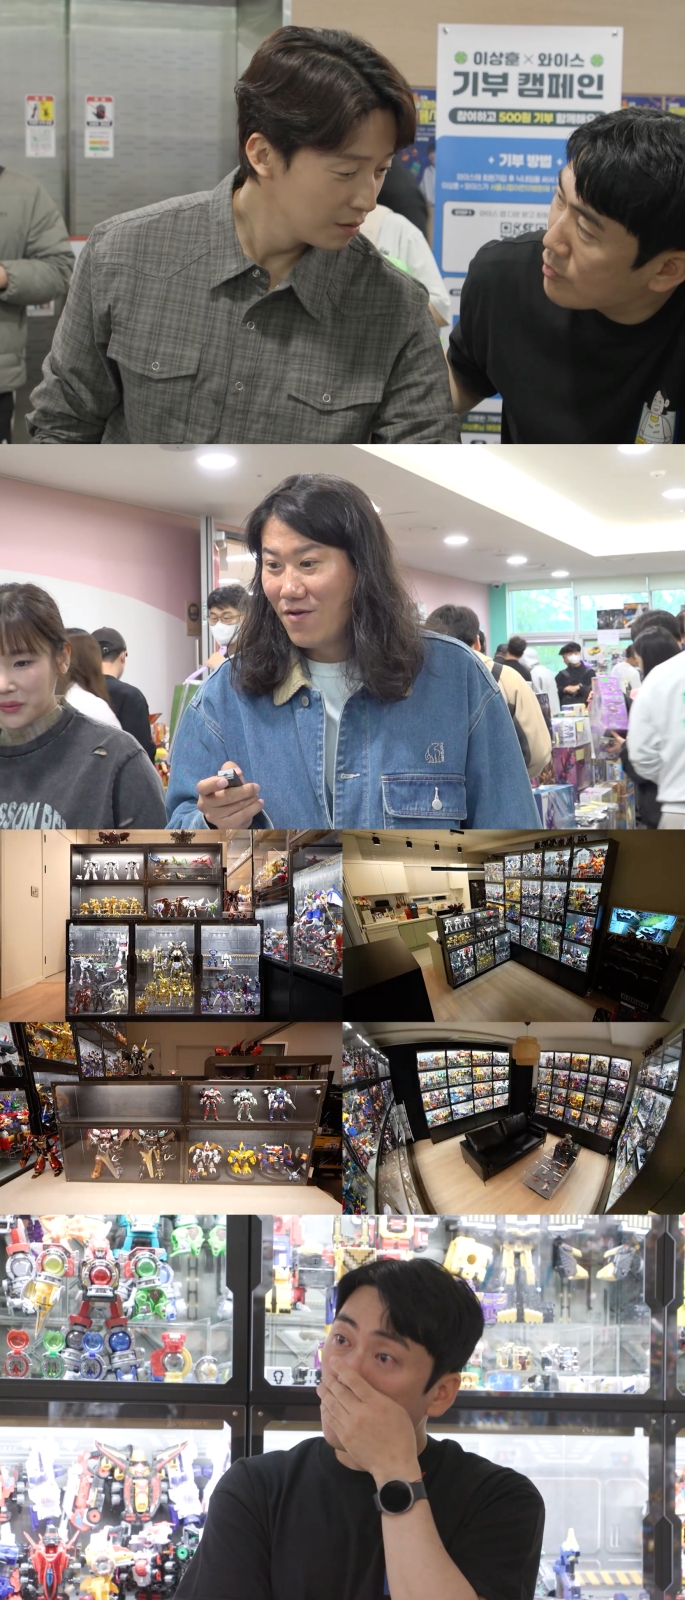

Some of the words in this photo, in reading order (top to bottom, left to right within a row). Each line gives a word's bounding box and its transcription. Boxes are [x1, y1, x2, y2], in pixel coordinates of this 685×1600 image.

[473, 51, 520, 66] 이상훈
[538, 53, 585, 68] 와이스
[453, 71, 509, 97] 기부
[518, 72, 604, 100] 캠페인
[498, 111, 531, 124] 500원
[533, 112, 554, 124] 기부
[499, 153, 525, 168] 기부
[526, 154, 553, 169] 방법
